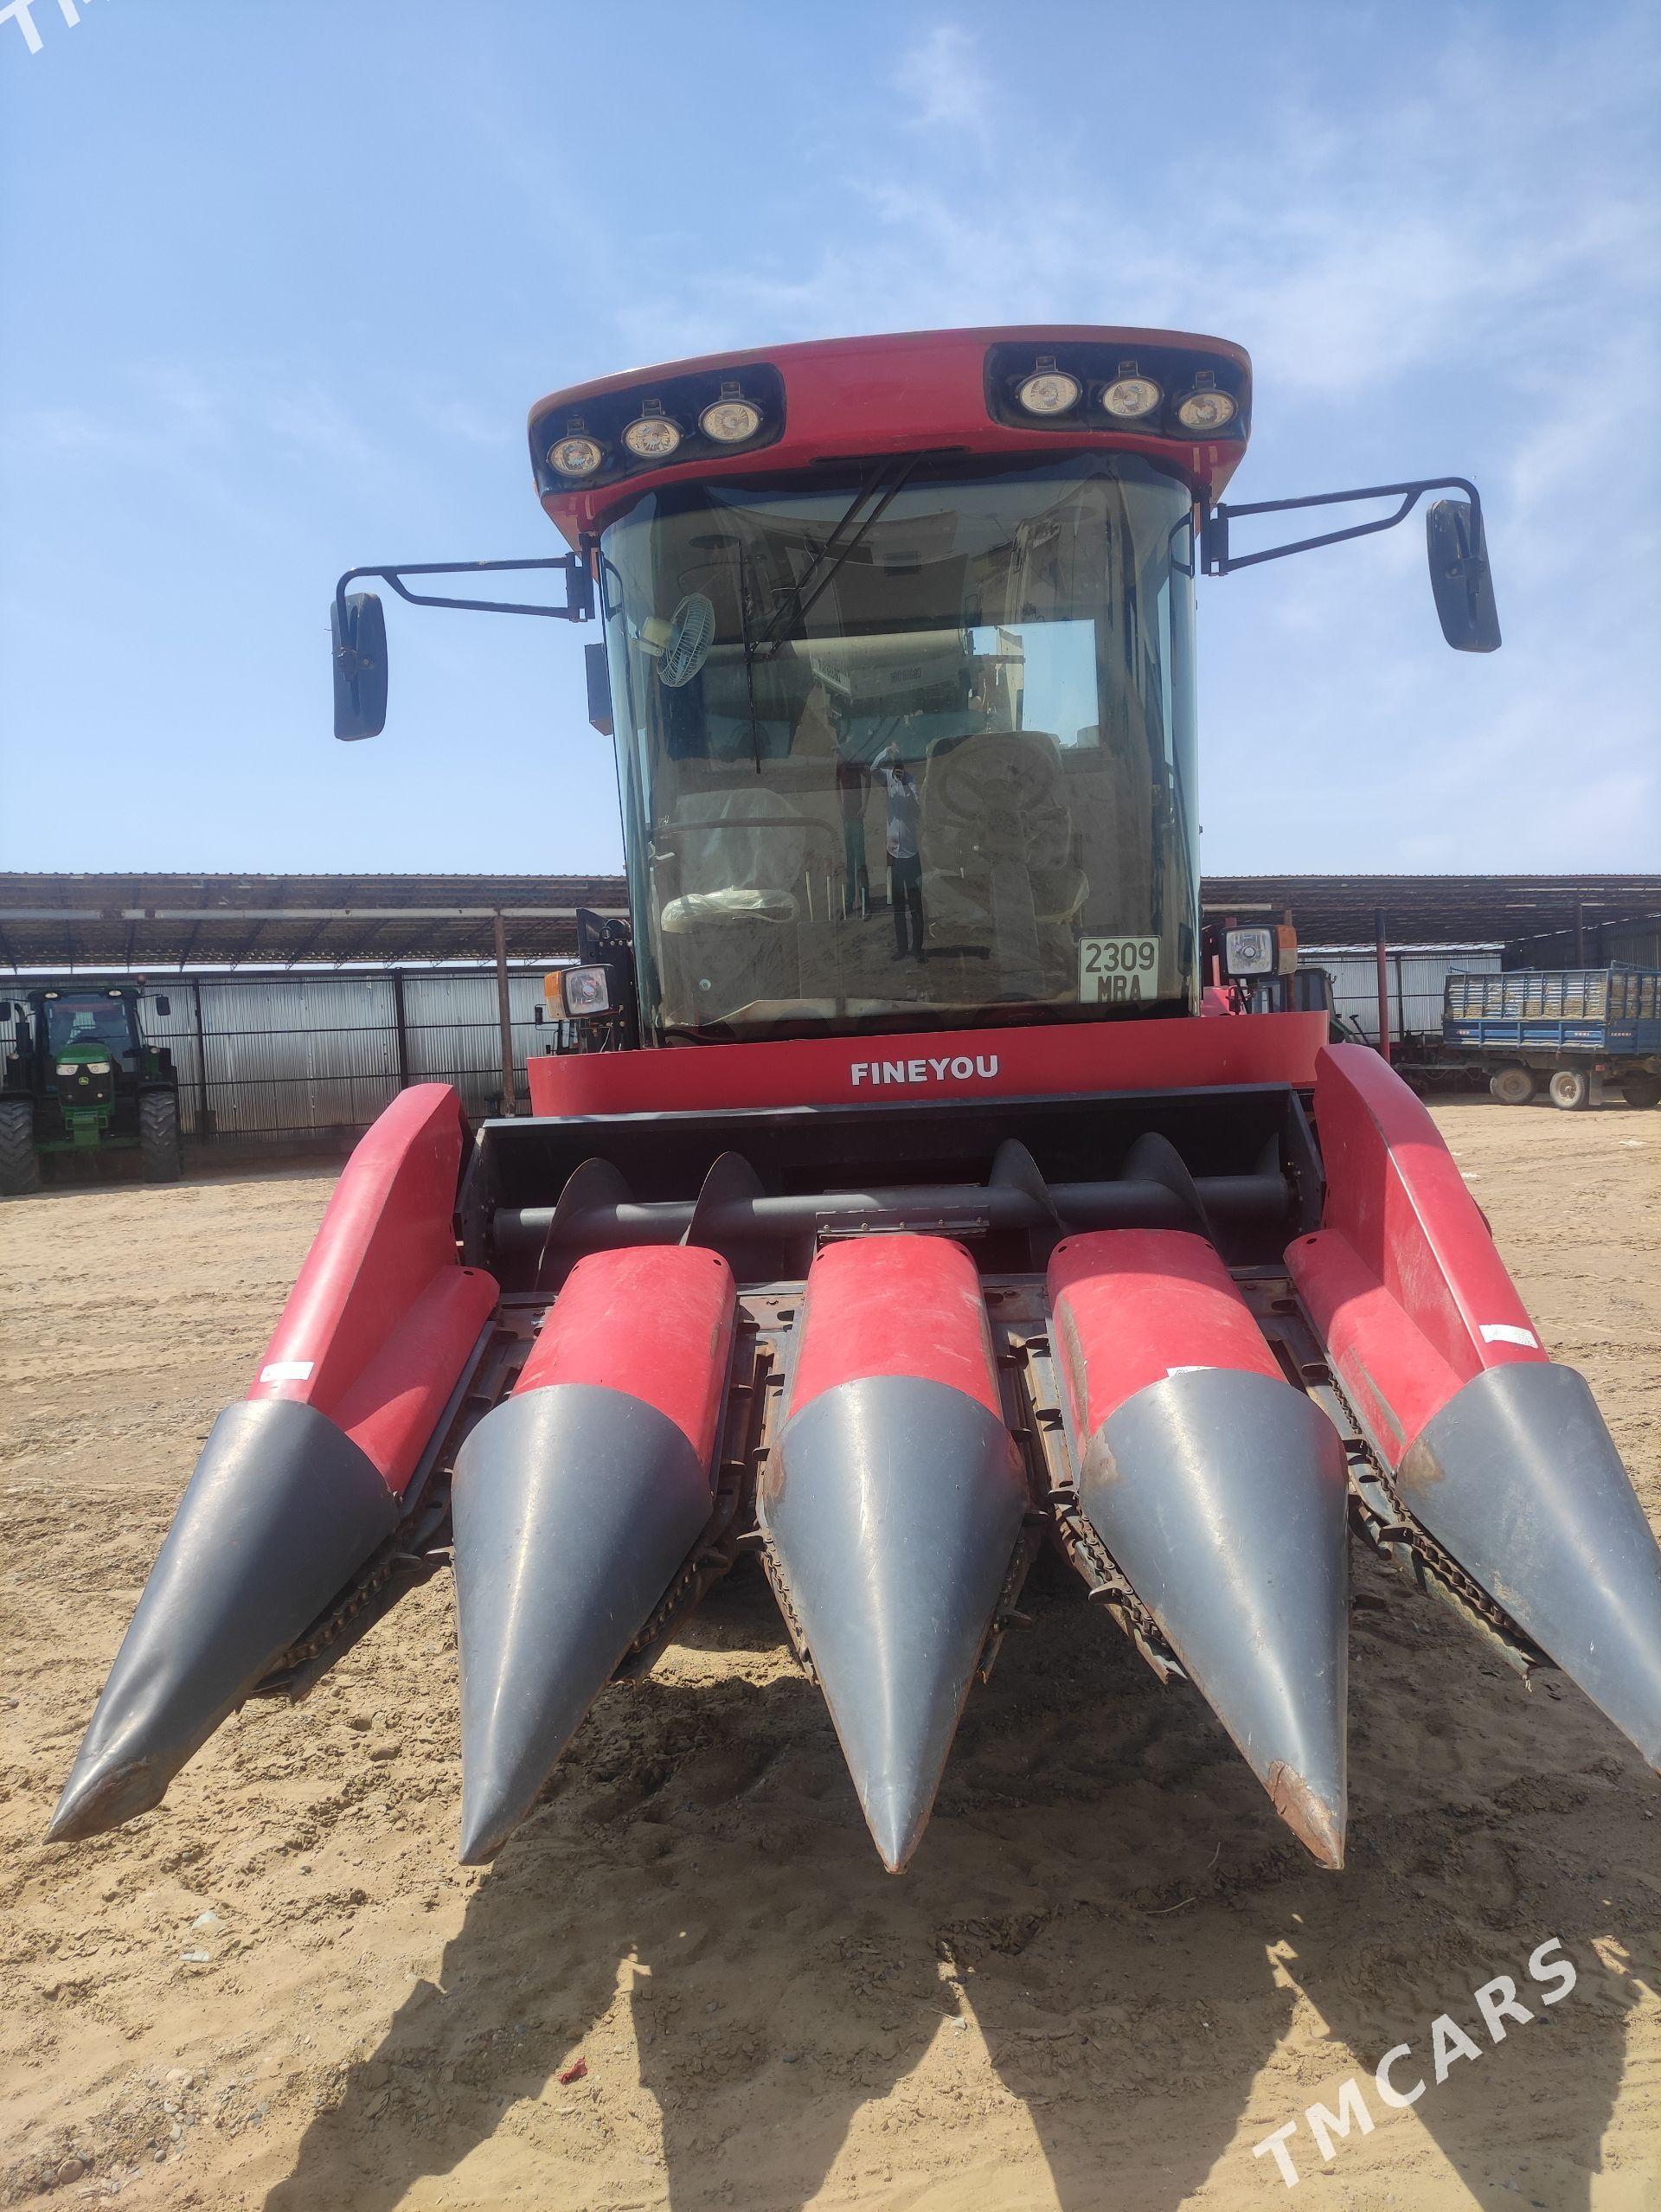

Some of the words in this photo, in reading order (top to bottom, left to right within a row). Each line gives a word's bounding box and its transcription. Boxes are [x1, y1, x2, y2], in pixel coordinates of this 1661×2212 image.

[1085, 941, 1155, 972] 2309
[1098, 975, 1142, 1003] MRA
[851, 1055, 998, 1086] FINEYOU
